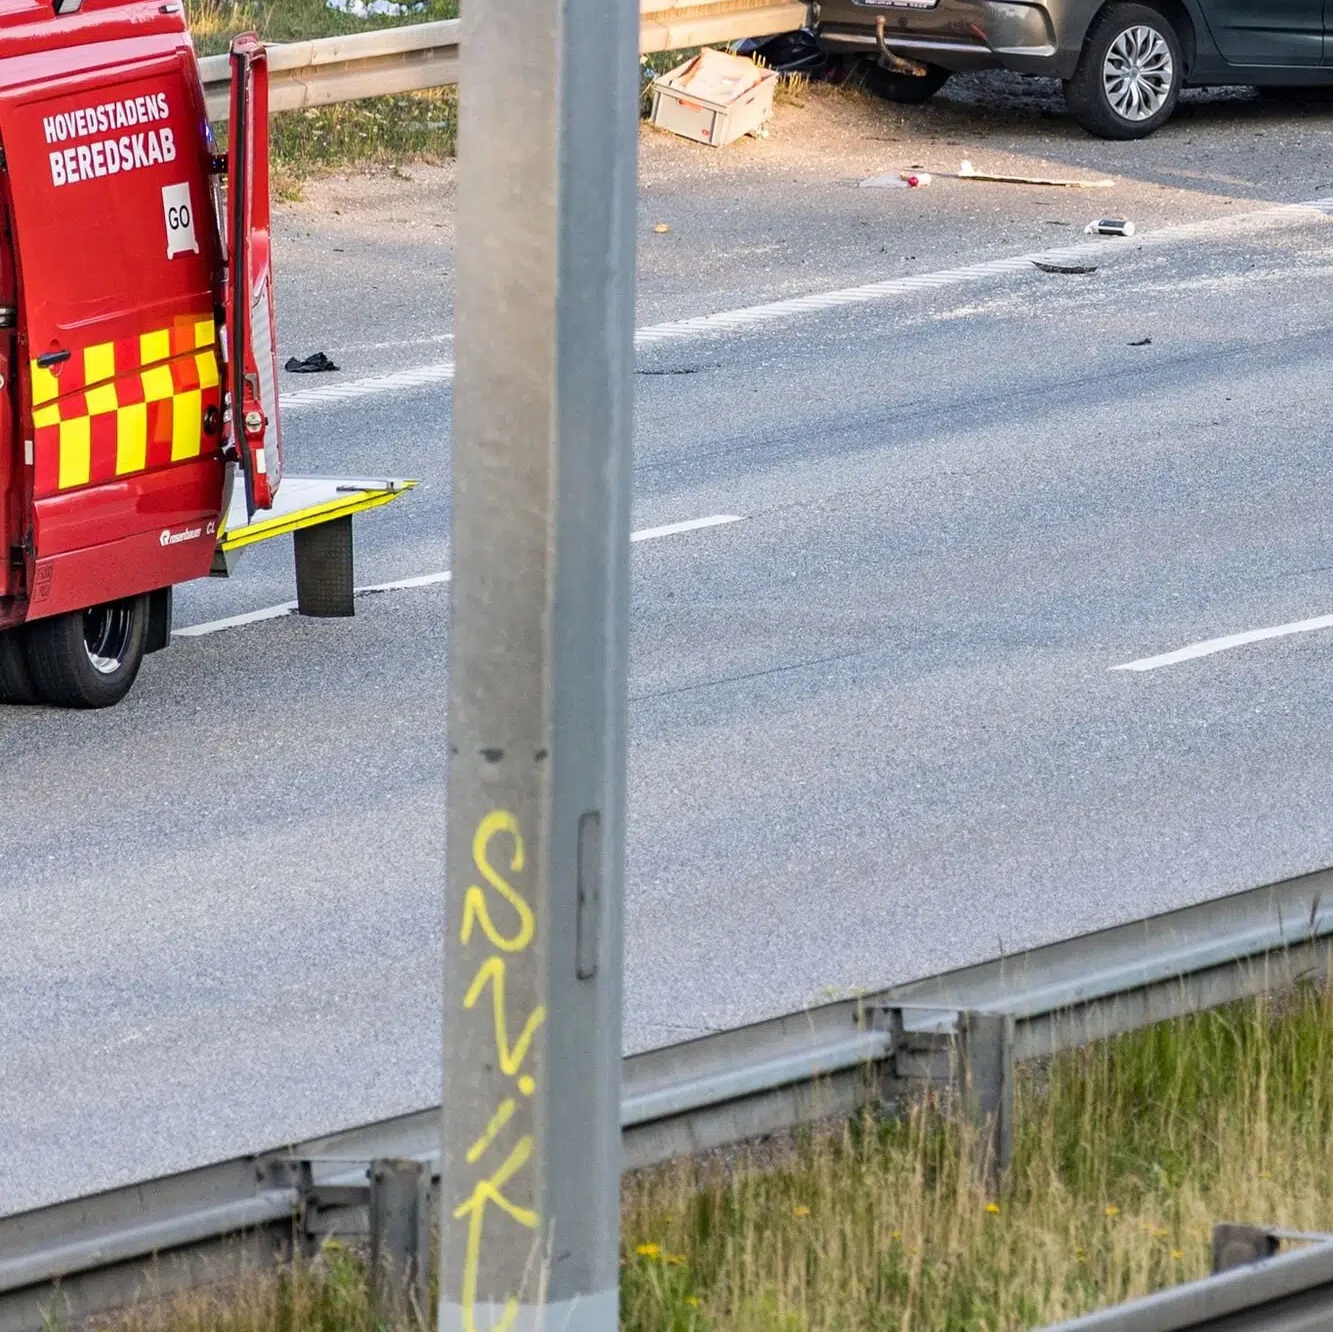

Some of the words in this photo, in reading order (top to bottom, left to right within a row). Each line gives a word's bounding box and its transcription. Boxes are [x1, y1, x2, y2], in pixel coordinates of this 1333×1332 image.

[43, 92, 170, 144] HOVEDSTADENS
[49, 127, 177, 187] BEREDSKAB
[168, 204, 190, 230] GO
